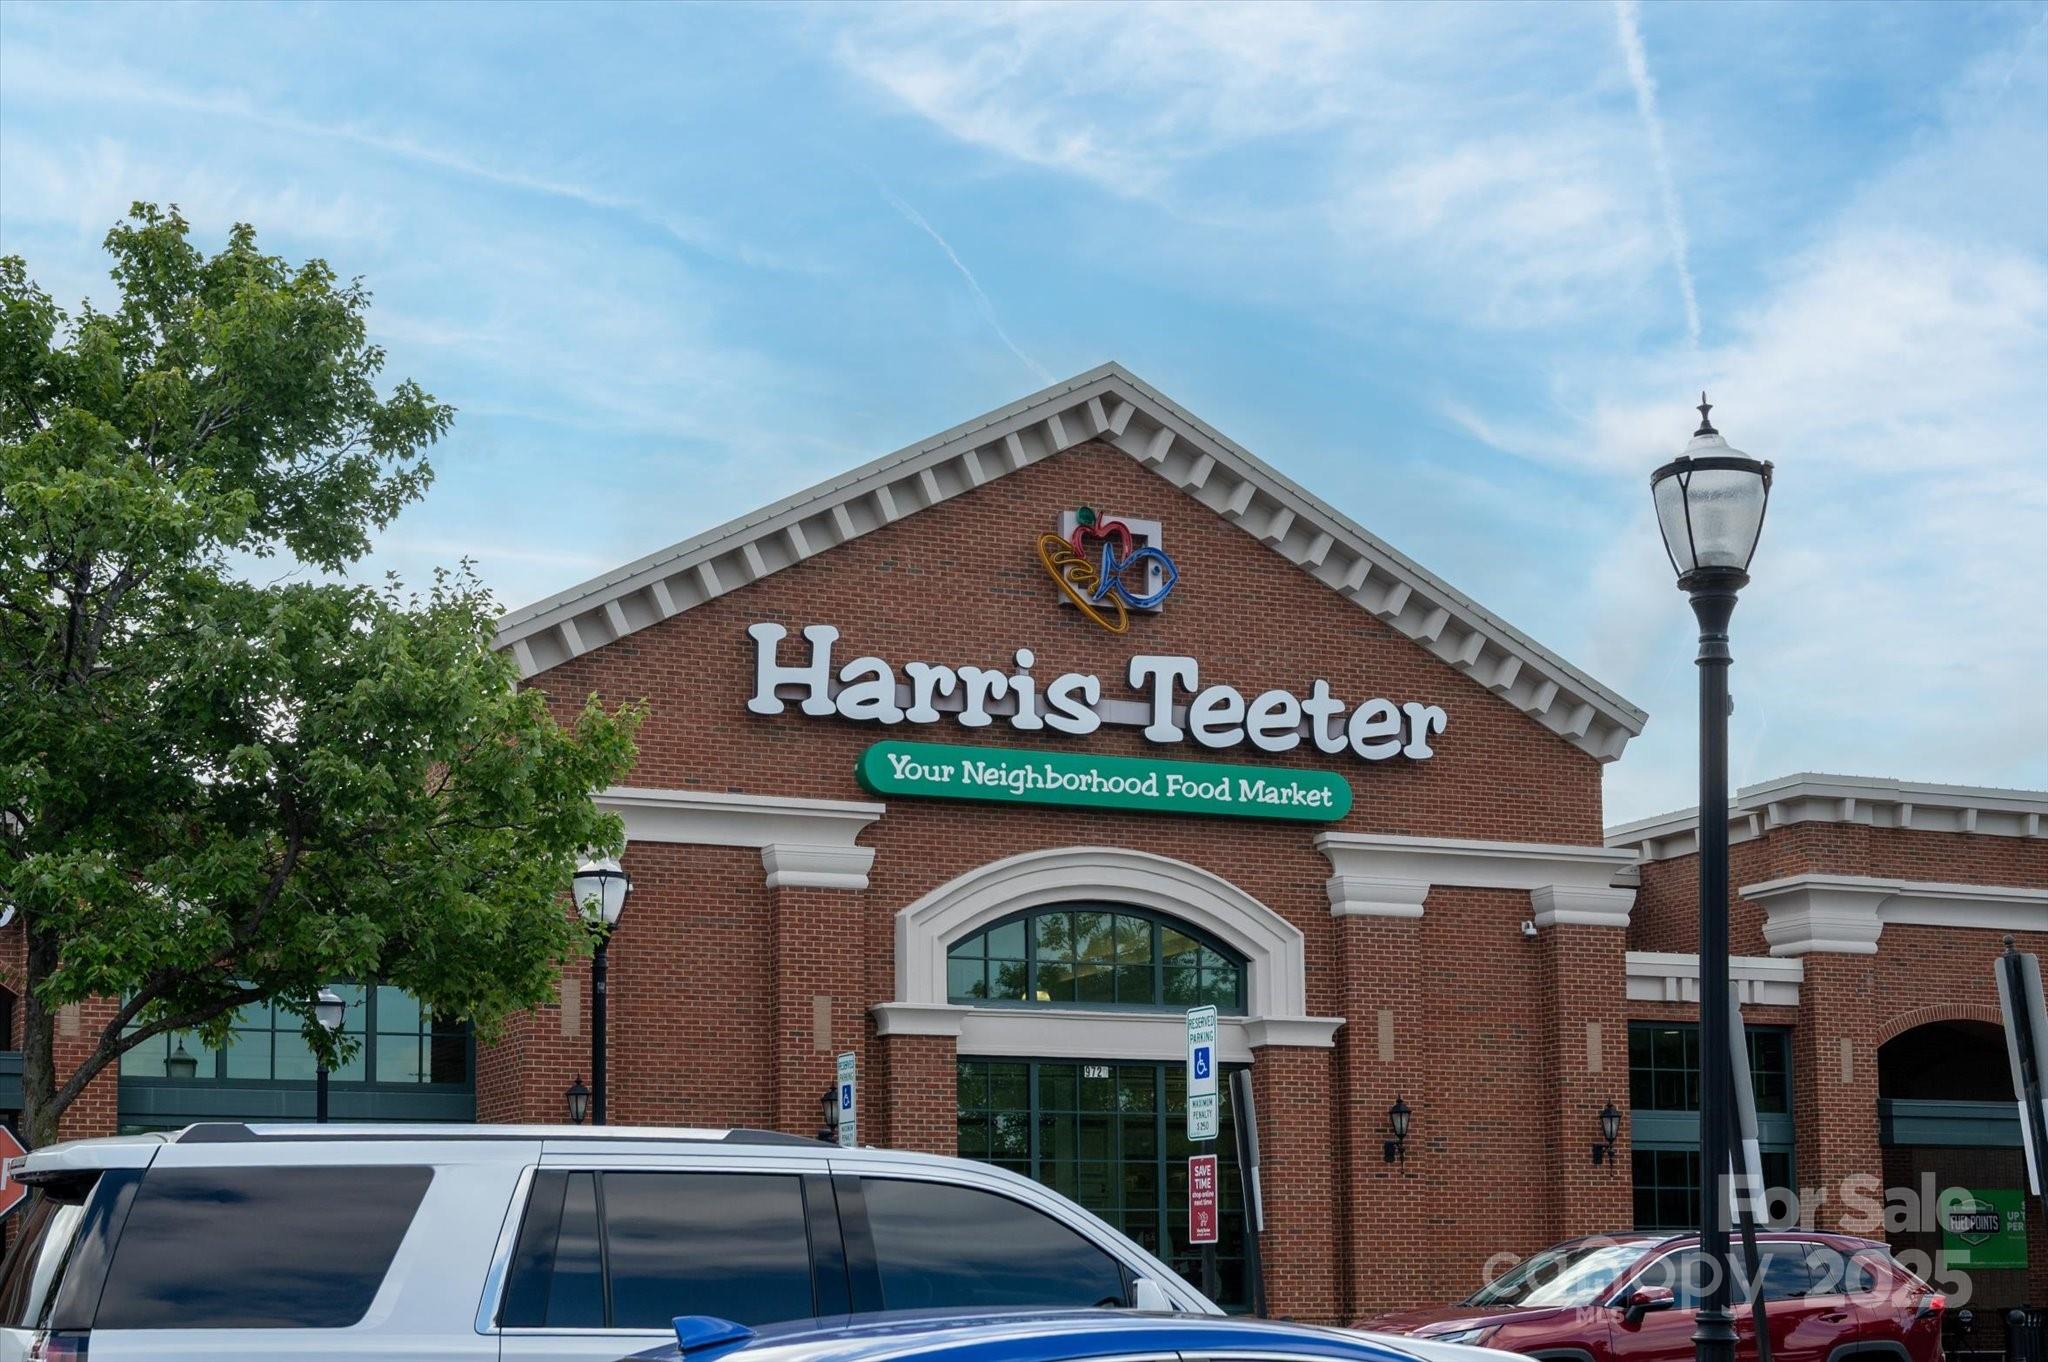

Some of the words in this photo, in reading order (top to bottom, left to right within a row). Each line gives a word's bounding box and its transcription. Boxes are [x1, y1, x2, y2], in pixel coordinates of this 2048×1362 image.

[747, 623, 1101, 735] Harris
[1128, 655, 1448, 761] Teeter
[887, 753, 955, 782] Your
[961, 760, 1159, 797] Neighborhood
[1166, 773, 1232, 802] Food
[1238, 779, 1333, 807] Market
[1189, 1015, 1215, 1029] RESERVED
[1190, 1030, 1214, 1044] PARKING
[1192, 1098, 1213, 1109] MAXIMUM
[1193, 1109, 1212, 1120] PENALTY
[1194, 1165, 1211, 1177] SAVE
[1195, 1177, 1211, 1189] TIME
[1950, 1215, 1970, 1231] FUEL
[1970, 1215, 1999, 1231] POINTS
[2007, 1221, 2024, 1231] PER
